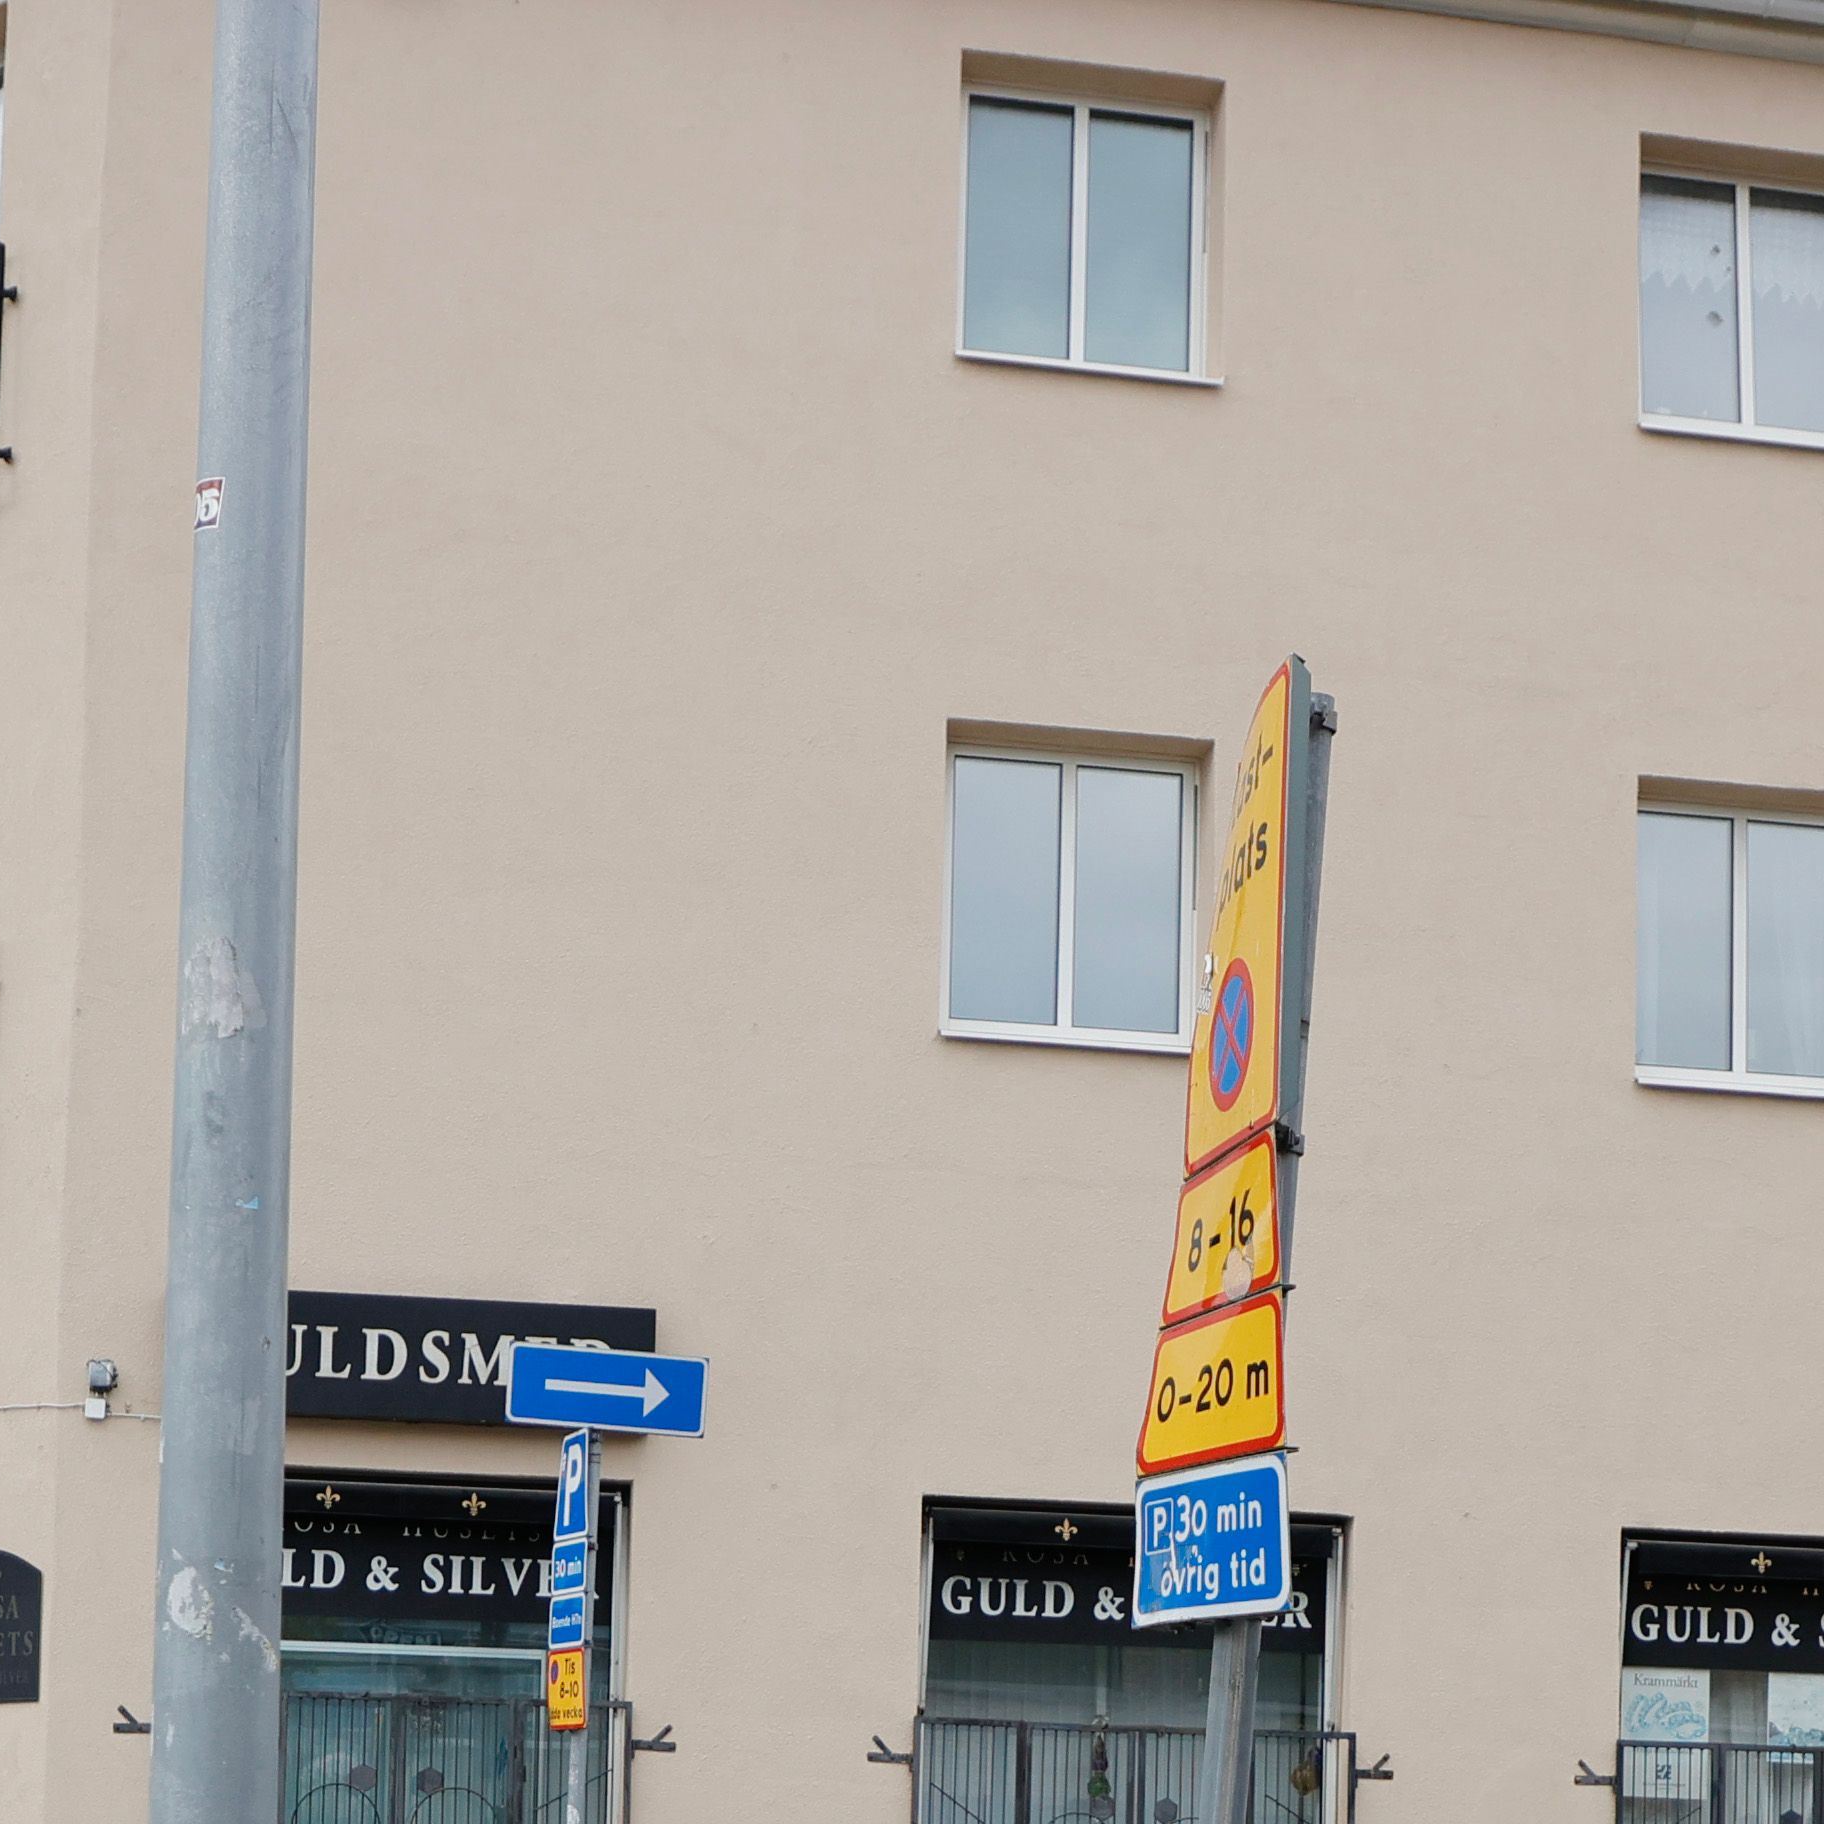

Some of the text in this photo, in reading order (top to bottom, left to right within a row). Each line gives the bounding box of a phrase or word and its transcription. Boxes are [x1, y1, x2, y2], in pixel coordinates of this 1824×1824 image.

[1215, 818, 1268, 932] plats
[286, 1323, 612, 1386] ULDSM
[1157, 1357, 1269, 1423] 0-20 m
[563, 1443, 582, 1527] P
[1175, 1494, 1208, 1543] 30
[1216, 1491, 1263, 1533] min
[281, 1547, 600, 1599] LD & SILV
[941, 1575, 1125, 1621] GULD &
[1160, 1547, 1267, 1601] övrig tid
[1631, 1603, 1755, 1645] GULD
[1771, 1612, 1801, 1648] &
[564, 1658, 576, 1676] Tis
